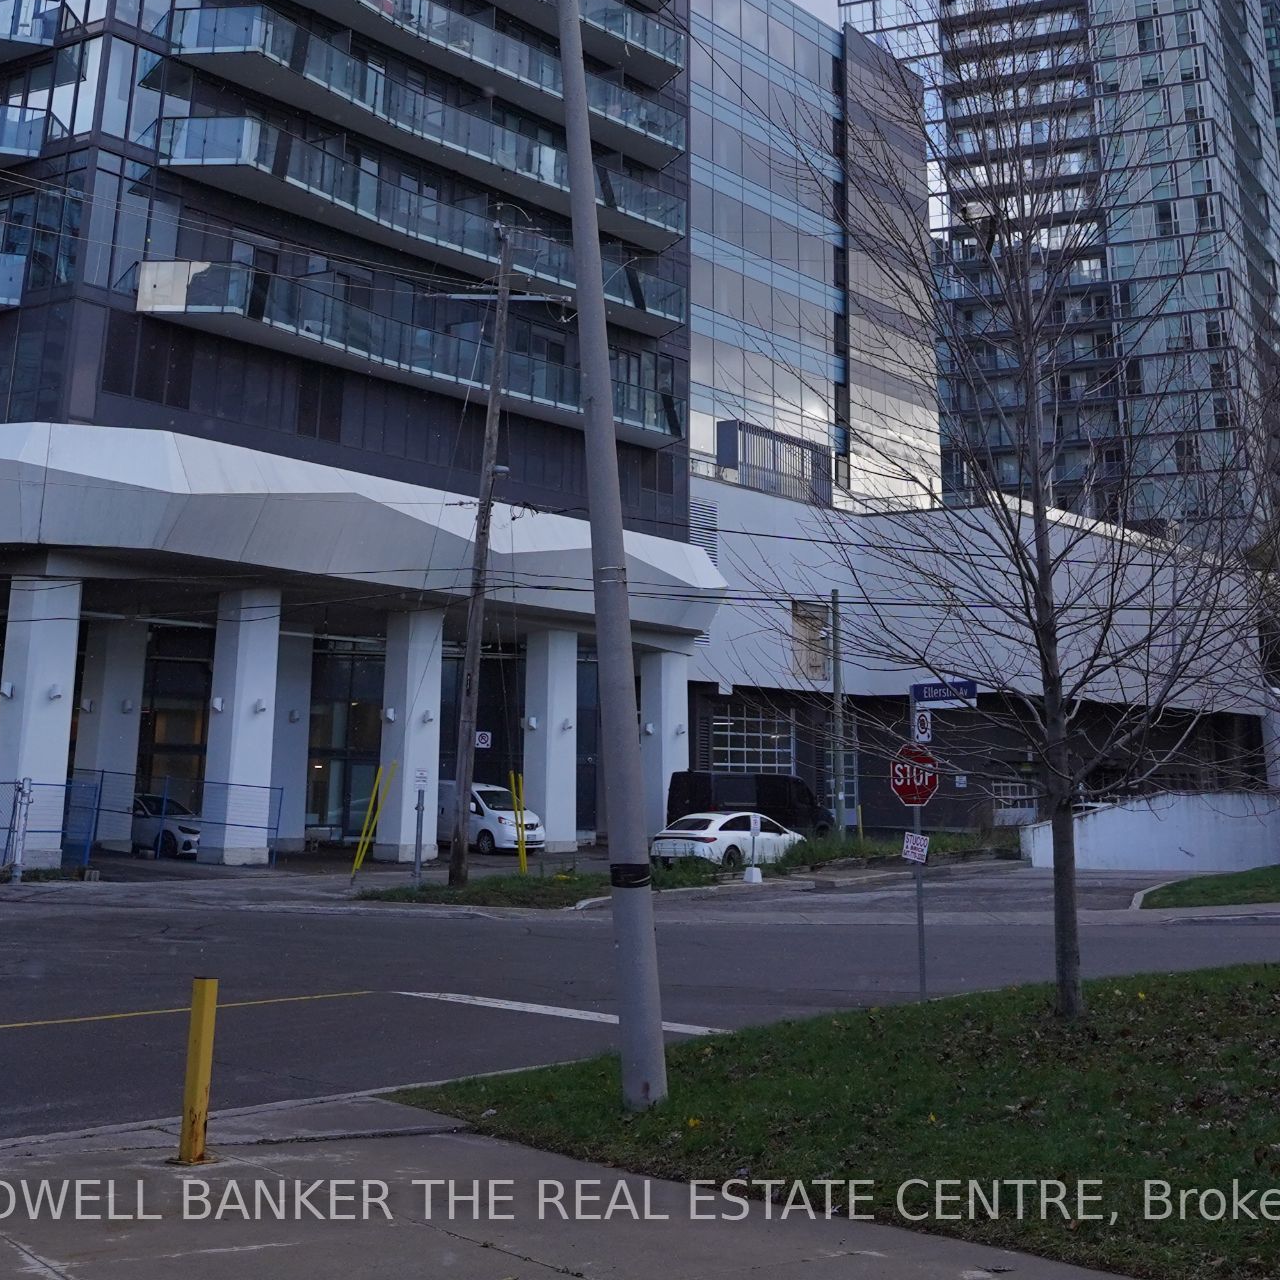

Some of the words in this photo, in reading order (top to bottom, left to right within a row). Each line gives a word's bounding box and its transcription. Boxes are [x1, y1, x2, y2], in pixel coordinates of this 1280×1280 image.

[923, 687, 957, 698] Ellersli
[894, 763, 933, 786] STOP
[905, 834, 928, 848] STUCCO
[910, 845, 924, 853] BRICK
